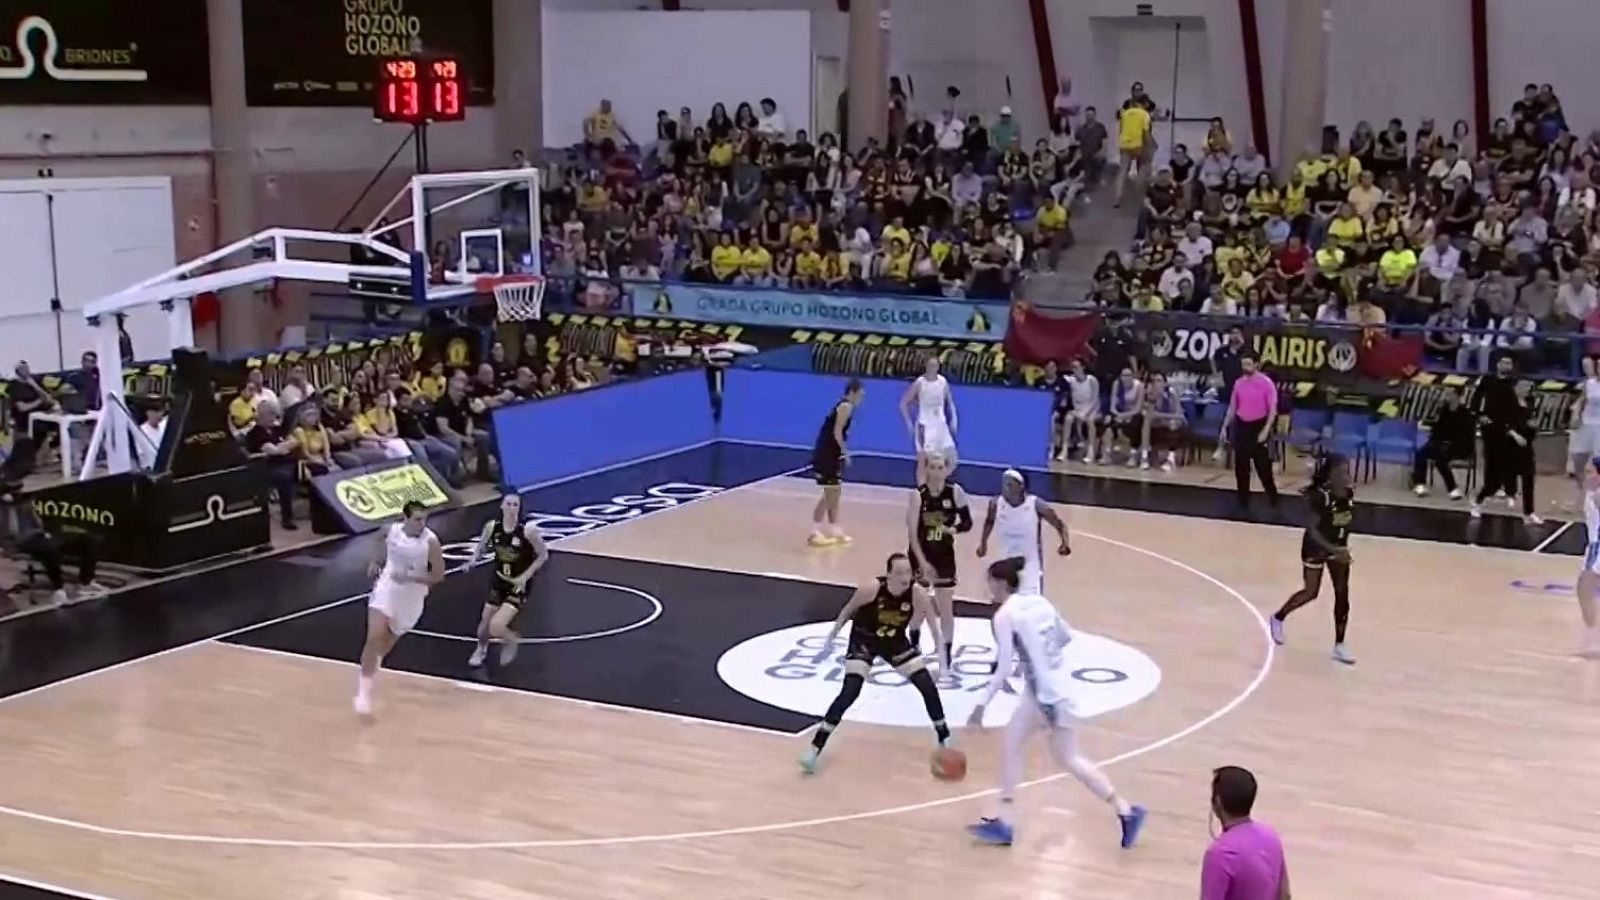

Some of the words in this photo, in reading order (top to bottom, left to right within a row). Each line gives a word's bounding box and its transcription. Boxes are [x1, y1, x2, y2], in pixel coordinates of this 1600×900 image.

[345, 13, 420, 36] HOZONO
[346, 35, 411, 55] GLOBAL
[388, 81, 418, 114] 13
[435, 81, 458, 114] 13
[697, 297, 747, 312] GRADA
[751, 299, 801, 316] GRUPO
[807, 304, 875, 321] HOZONO
[878, 307, 940, 326] GLOBAL
[1174, 328, 1230, 361] ZON
